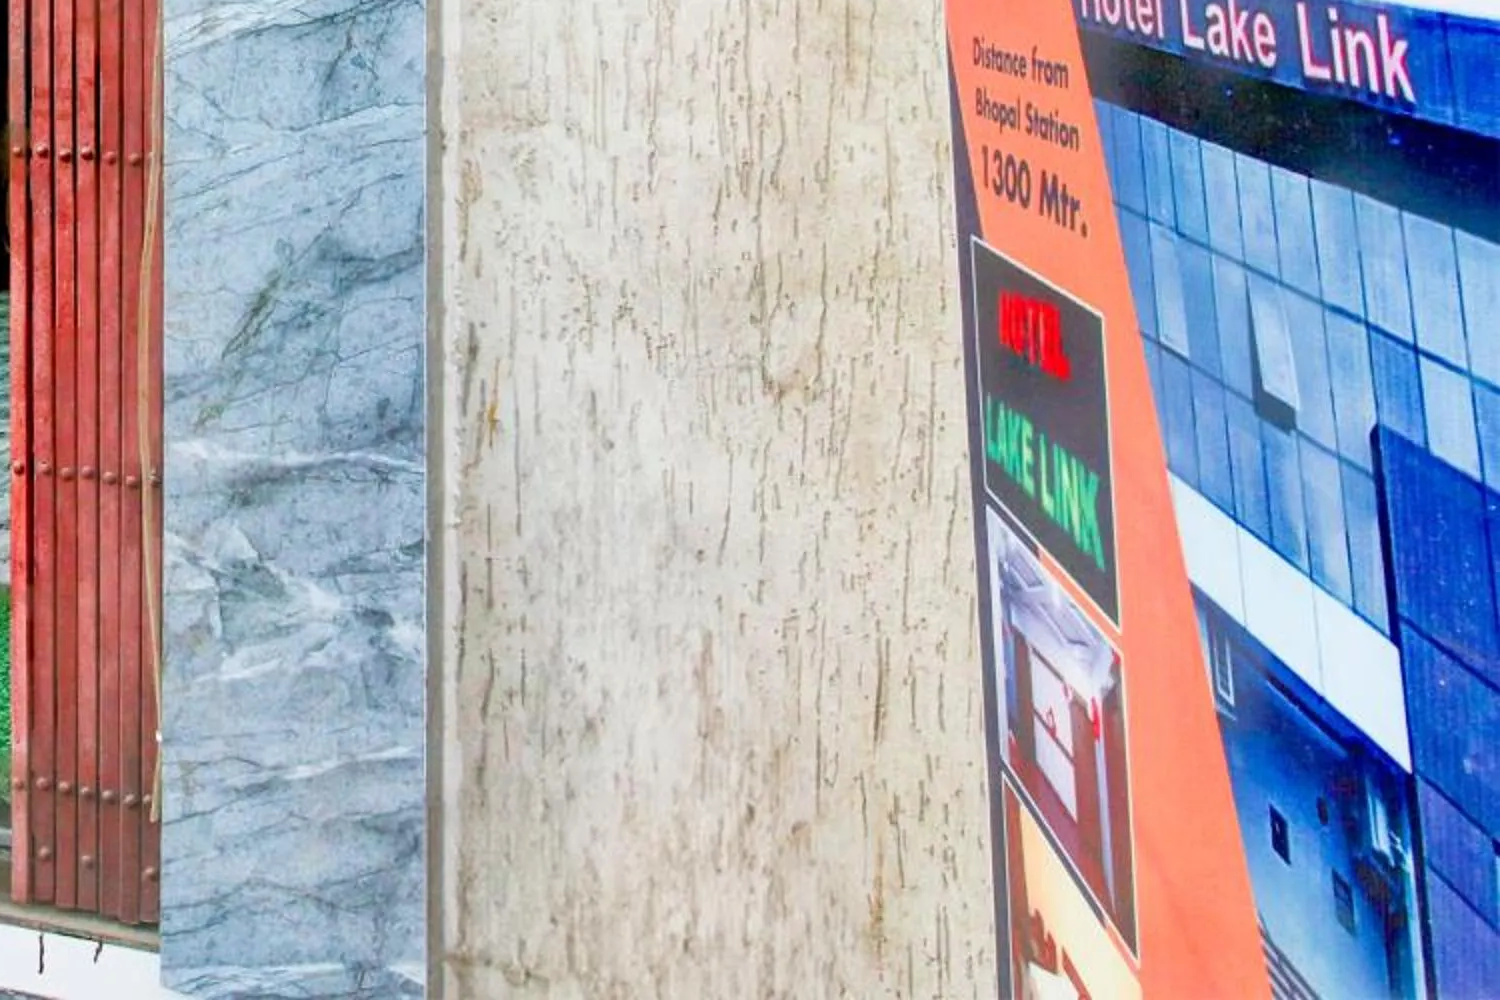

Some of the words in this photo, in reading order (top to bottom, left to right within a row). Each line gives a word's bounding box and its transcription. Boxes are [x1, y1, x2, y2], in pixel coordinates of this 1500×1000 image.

[972, 35, 1028, 79] Distance
[1030, 46, 1070, 89] from
[1296, 1, 1418, 104] Link
[974, 91, 1021, 143] Bhopal
[1025, 99, 1080, 153] Station
[980, 143, 1032, 210] 1300
[1038, 167, 1088, 238] Mtr.
[986, 391, 1035, 500] LAKE
[1039, 432, 1106, 572] LINK
